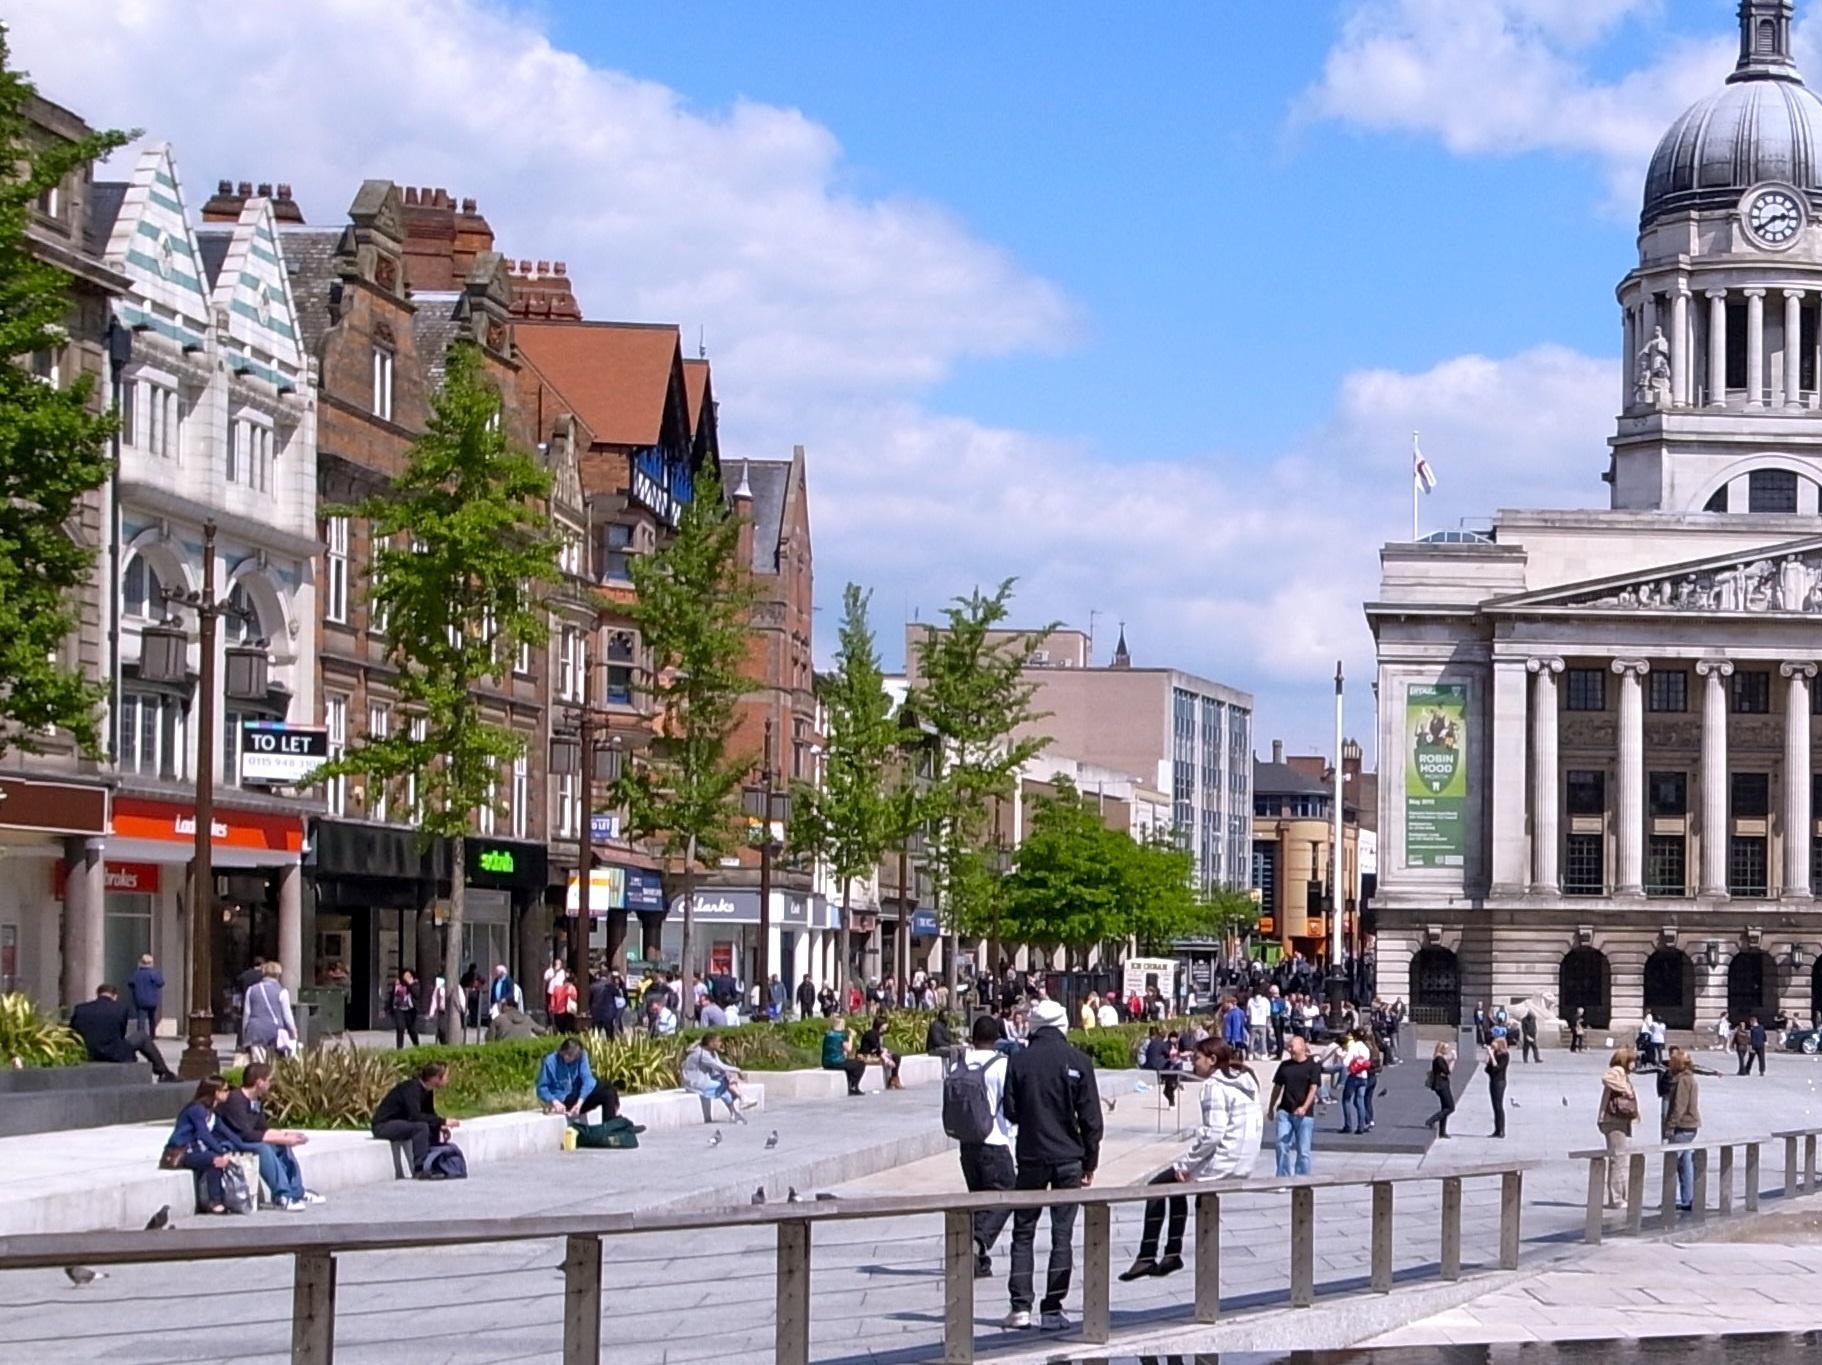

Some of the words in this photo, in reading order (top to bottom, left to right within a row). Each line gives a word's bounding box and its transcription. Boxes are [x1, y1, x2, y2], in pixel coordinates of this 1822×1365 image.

[251, 733, 276, 751] TO
[281, 735, 312, 753] LET
[1419, 754, 1454, 764] ROBIN
[1420, 764, 1453, 773] HOOD
[175, 813, 228, 838] Ladkes
